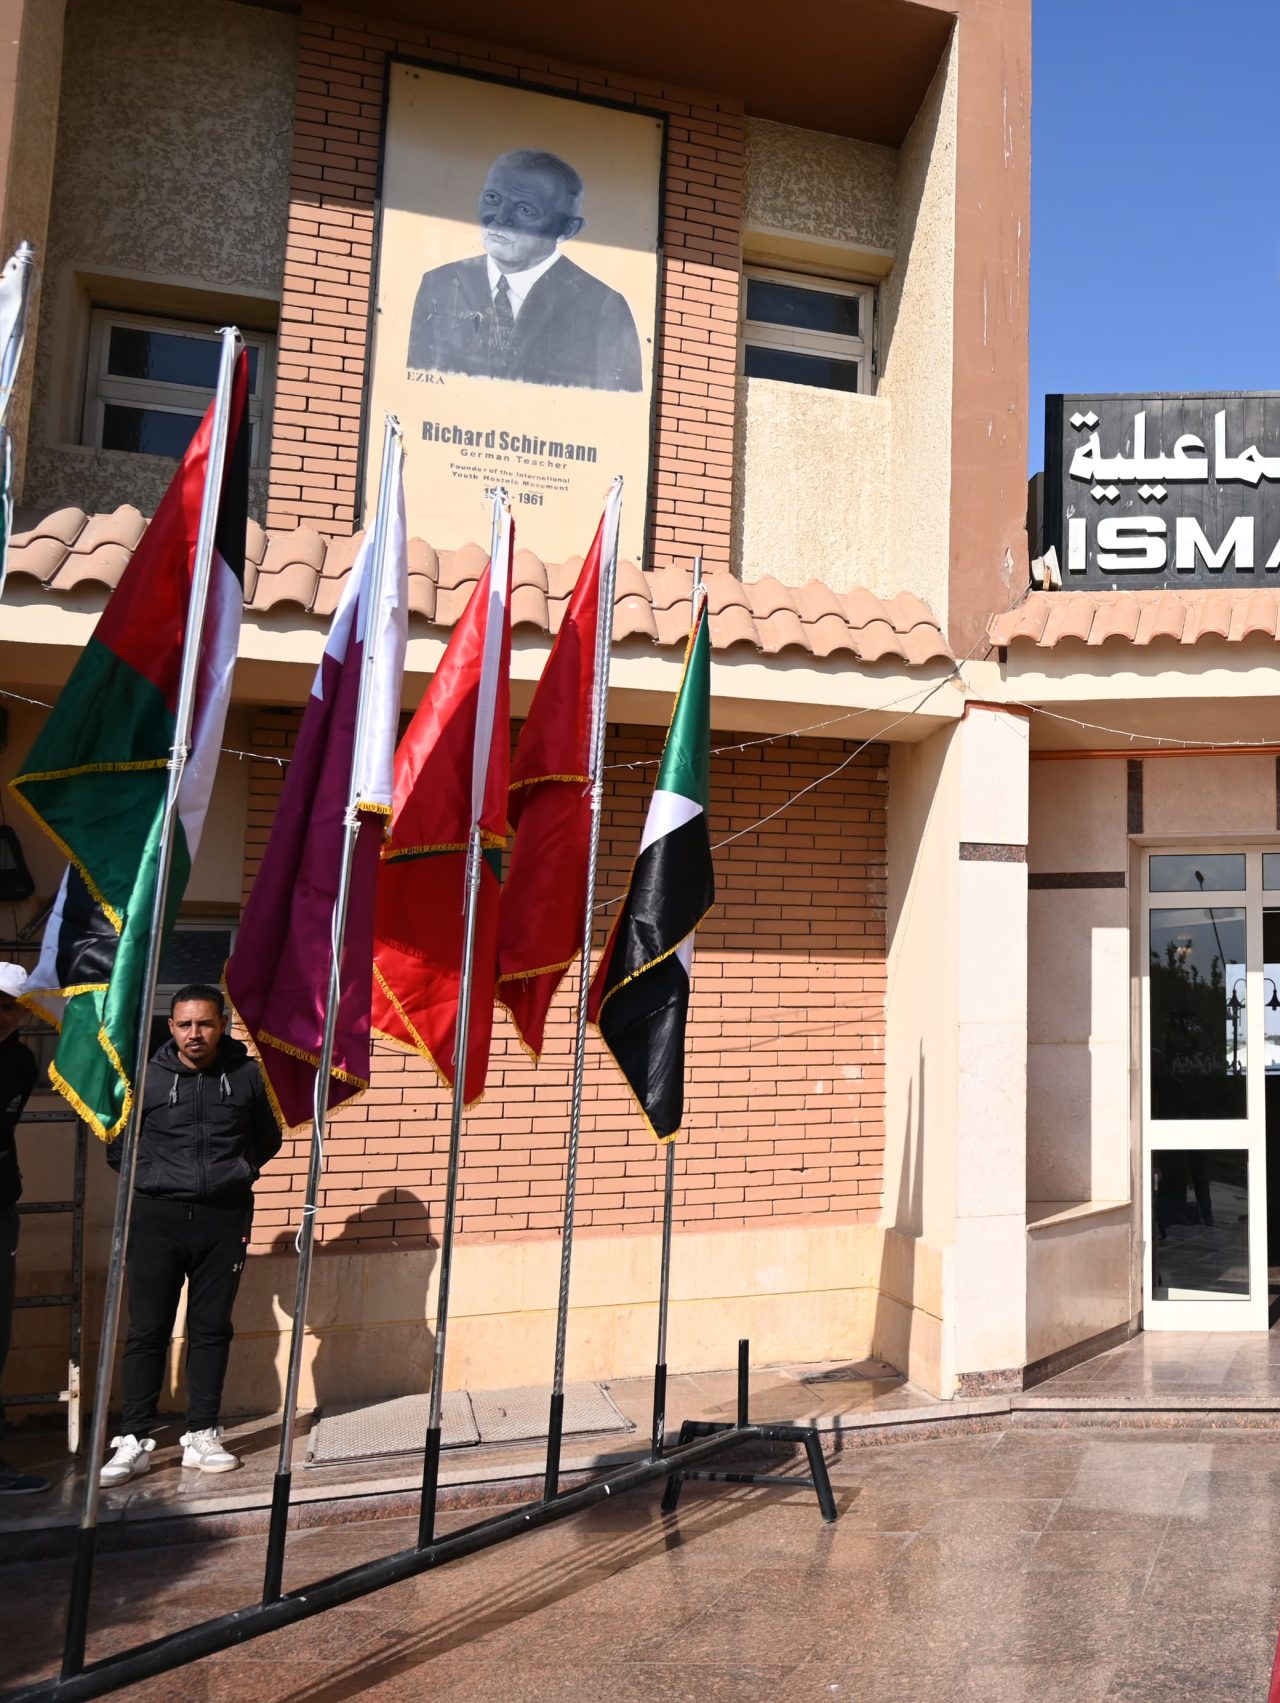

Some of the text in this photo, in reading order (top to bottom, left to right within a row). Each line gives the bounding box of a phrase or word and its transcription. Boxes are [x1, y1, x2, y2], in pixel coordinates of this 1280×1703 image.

[407, 371, 445, 384] EZRA
[421, 420, 598, 463] Richard Schirmann
[460, 449, 567, 469] German Teacher
[450, 462, 487, 473] Founder
[500, 469, 513, 477] the
[516, 472, 570, 484] International
[452, 471, 569, 492] Youth Hostels Movement
[518, 492, 544, 506] 1961
